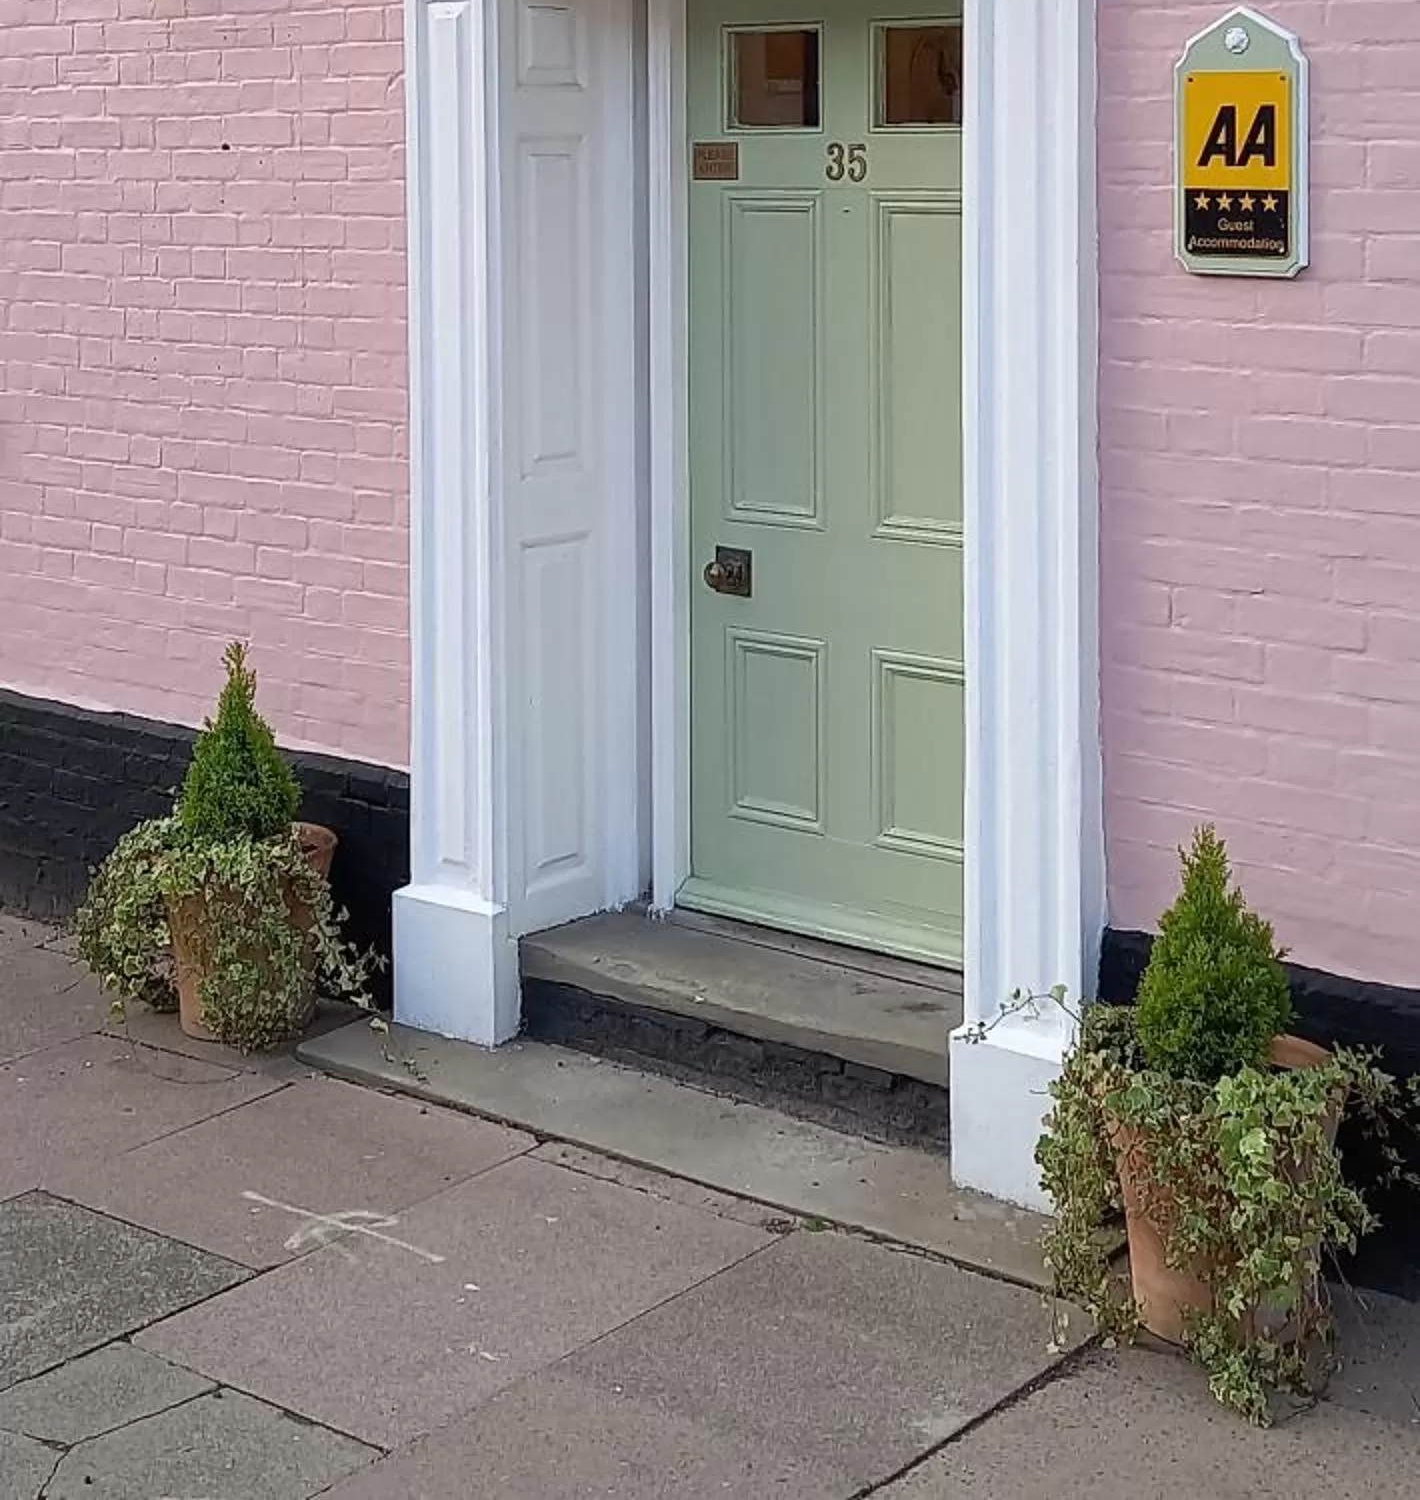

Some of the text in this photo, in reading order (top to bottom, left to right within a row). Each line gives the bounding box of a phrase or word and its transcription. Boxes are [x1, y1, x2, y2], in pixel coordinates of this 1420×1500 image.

[1197, 105, 1276, 167] AA
[825, 142, 867, 182] 35
[1217, 217, 1255, 232] Guest
[1189, 235, 1284, 250] Accommodation
